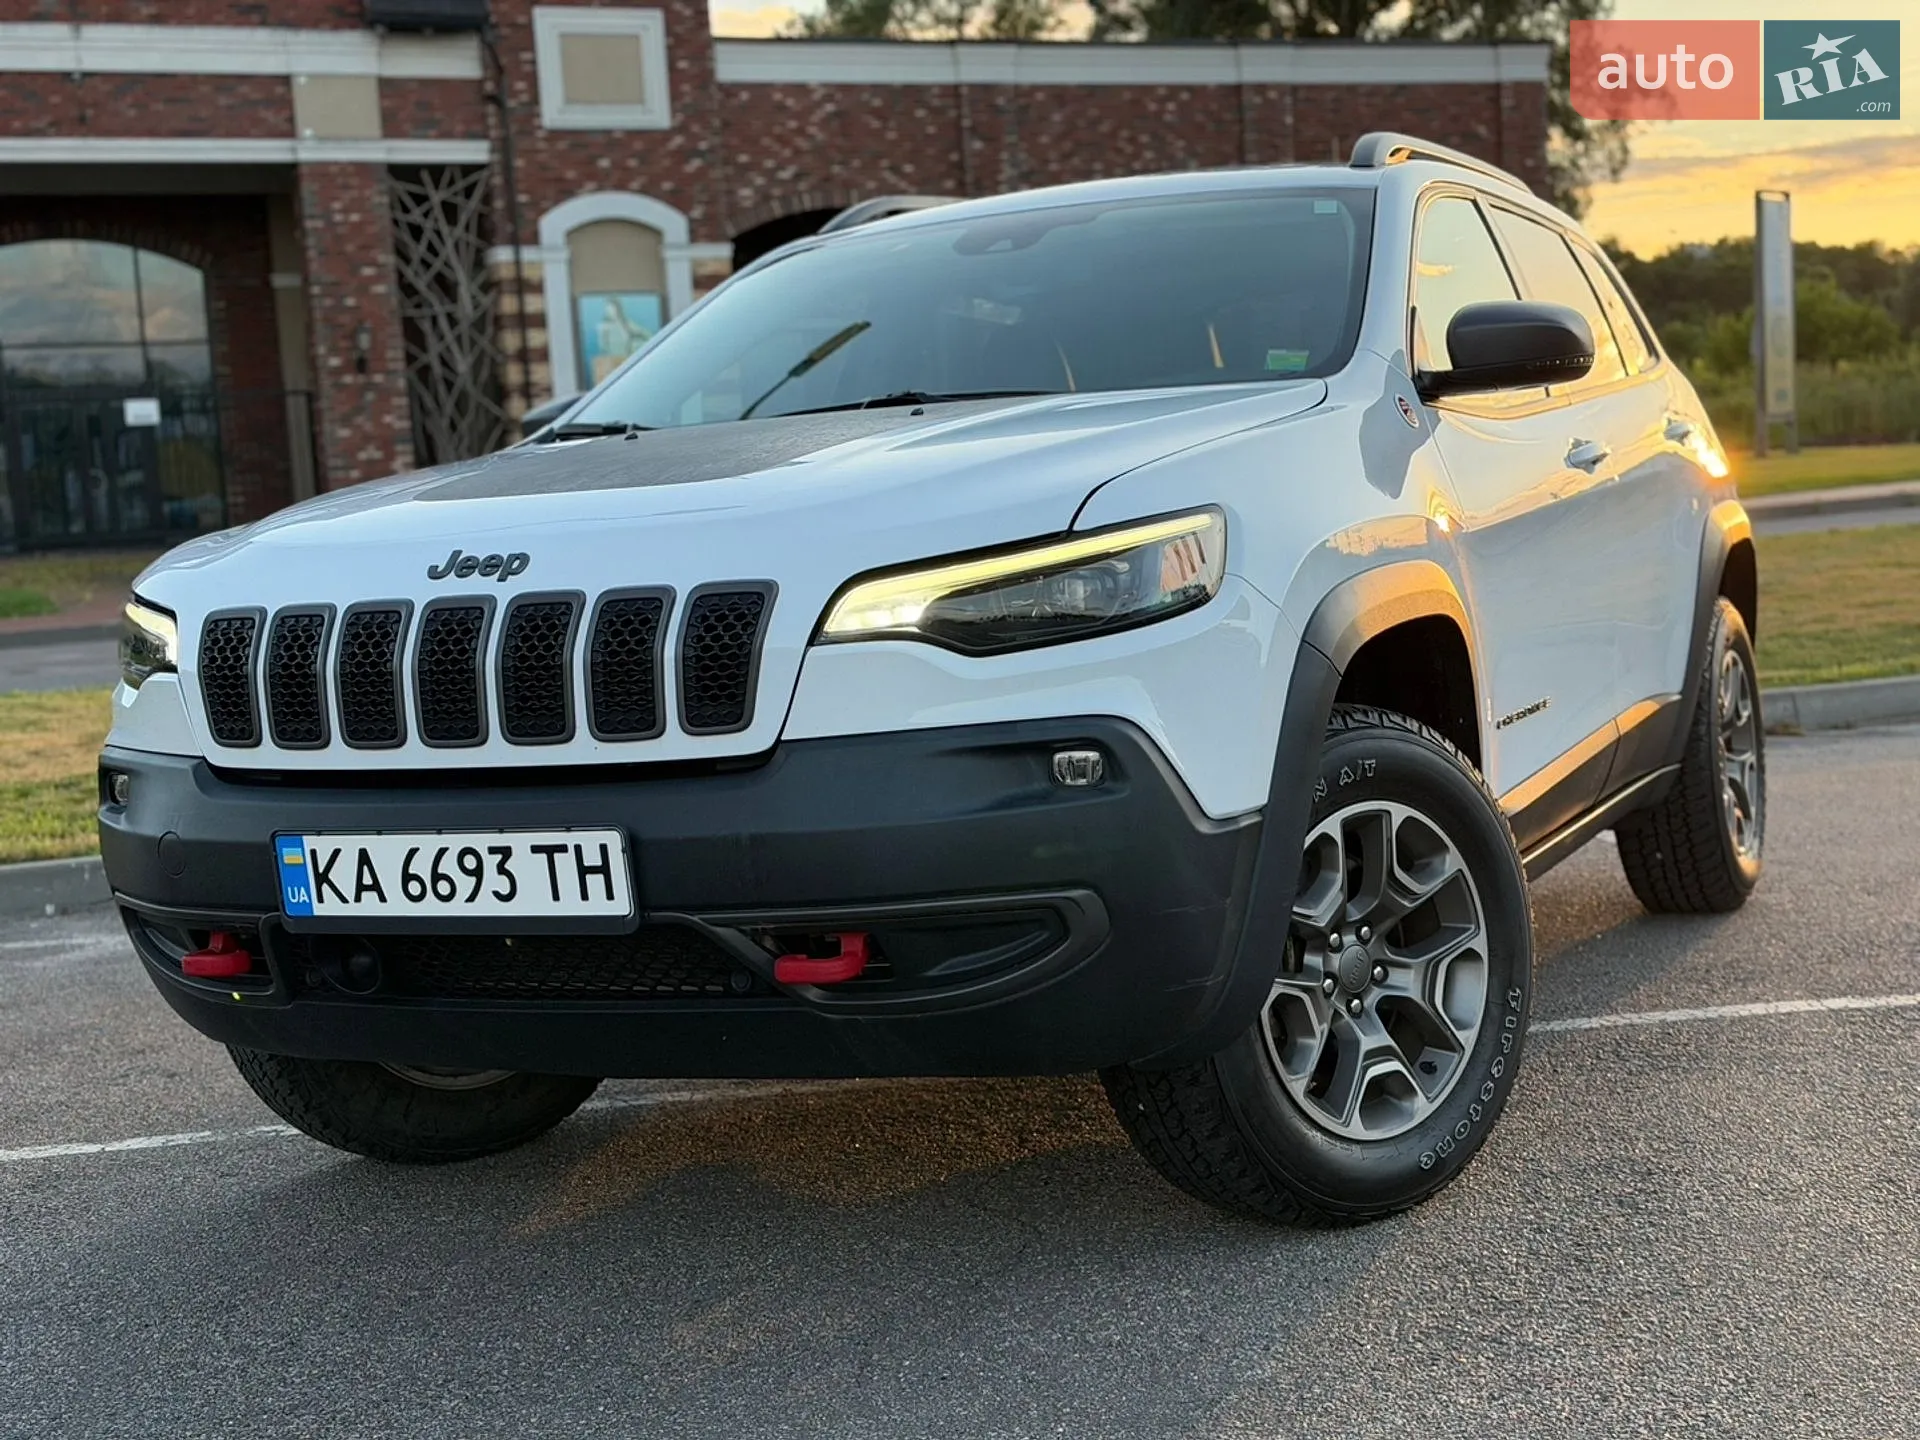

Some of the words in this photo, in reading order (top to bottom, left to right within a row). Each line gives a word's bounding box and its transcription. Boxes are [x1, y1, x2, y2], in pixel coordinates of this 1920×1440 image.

[427, 549, 531, 582] Jeep
[1339, 759, 1376, 786] A/T
[310, 847, 388, 904] KA
[401, 846, 517, 903] 6693
[530, 843, 615, 901] TH
[287, 886, 310, 903] UA
